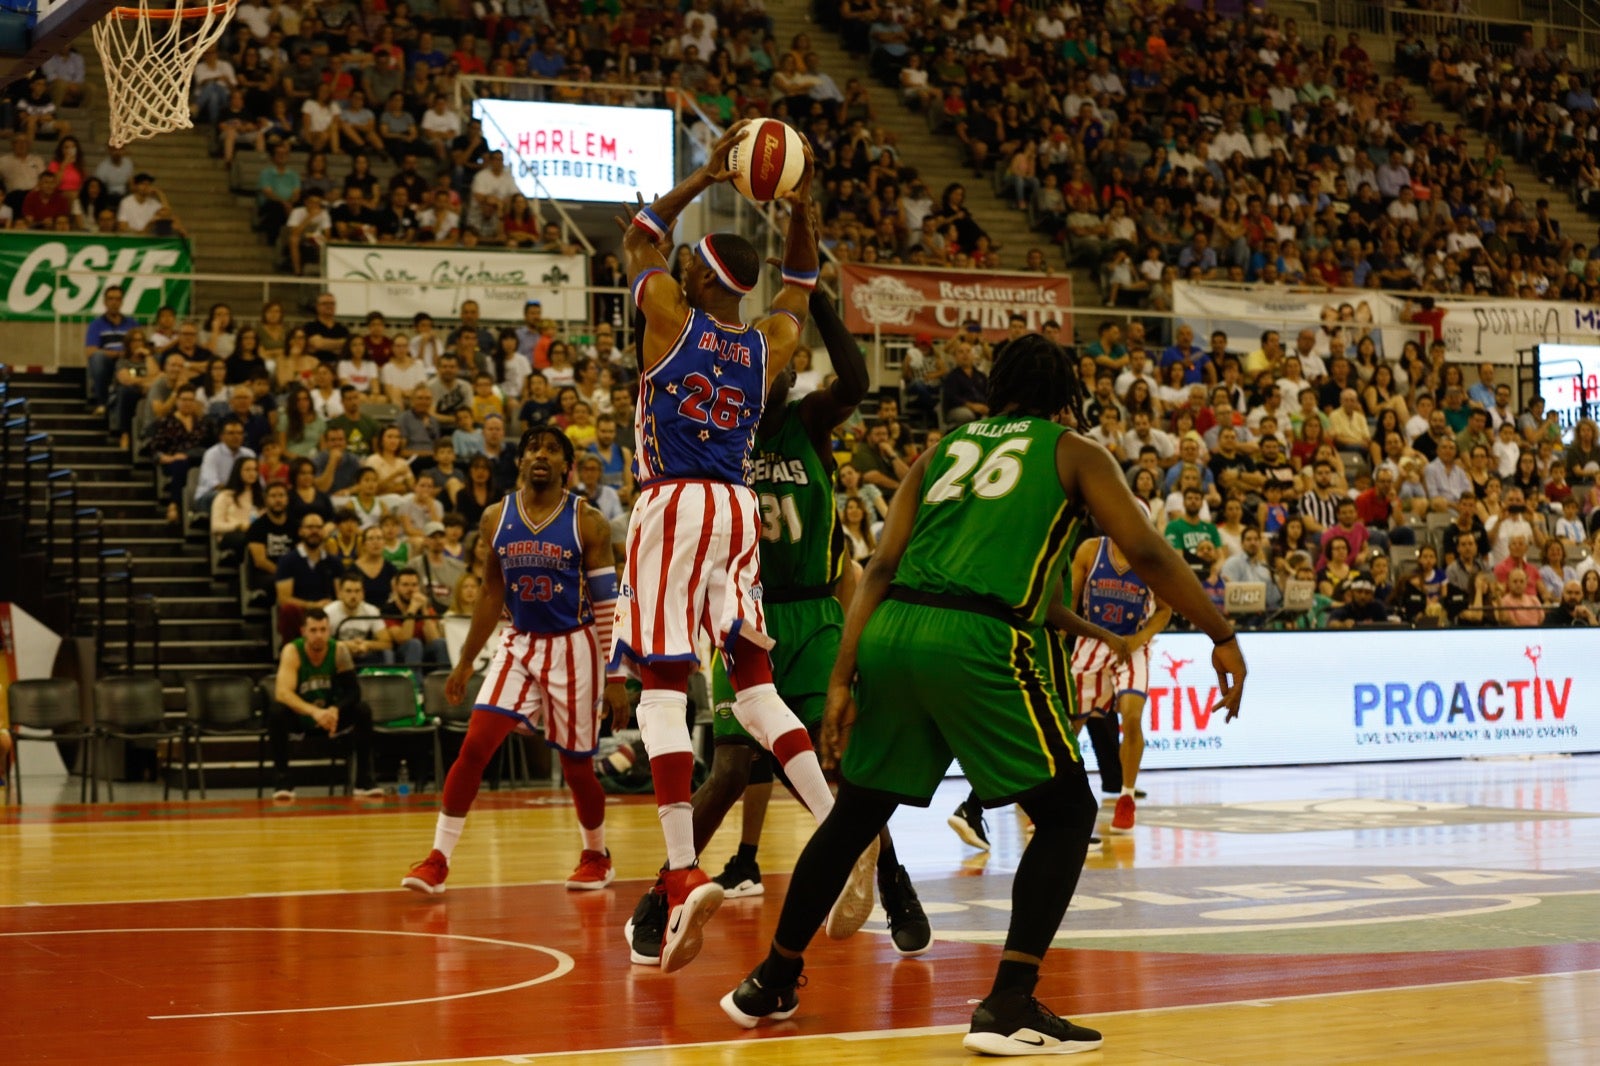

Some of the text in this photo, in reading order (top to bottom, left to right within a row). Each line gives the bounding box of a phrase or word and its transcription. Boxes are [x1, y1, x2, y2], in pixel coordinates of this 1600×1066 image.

[517, 129, 617, 161] HARLEM
[518, 160, 638, 187] OBETROTTERS
[7, 242, 181, 315] CSIF
[938, 281, 1057, 304] Restaurante
[677, 371, 746, 430] 26
[966, 420, 1031, 438] WILLIAMS
[923, 437, 1033, 505] 26
[760, 492, 803, 545] 31
[507, 540, 562, 561] HARLEM
[519, 575, 553, 602] 23
[1102, 603, 1124, 624] 21
[1147, 686, 1220, 732] TIV
[1354, 677, 1573, 727] PROACTIV
[1174, 736, 1223, 750] EVENTS
[1355, 732, 1382, 746] LIVE
[1385, 729, 1480, 744] ENTERTAINMENT
[1537, 724, 1579, 738] EVENTS
